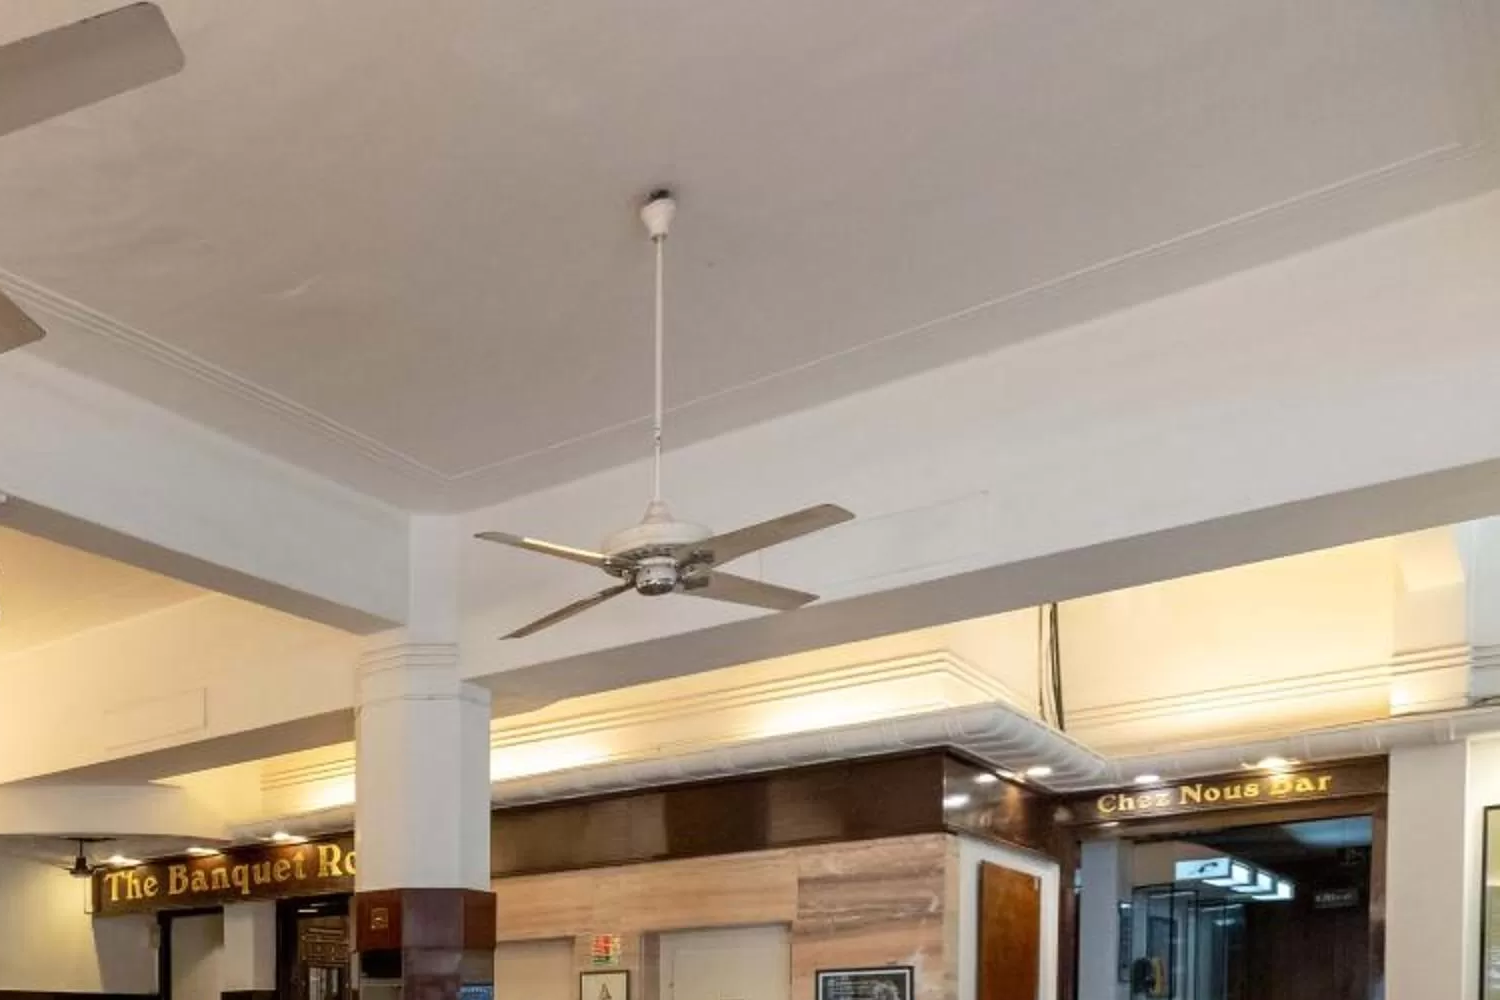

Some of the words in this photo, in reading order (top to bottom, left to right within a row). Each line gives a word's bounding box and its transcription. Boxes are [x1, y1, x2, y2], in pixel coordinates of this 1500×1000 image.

[1097, 793, 1170, 813] Chez
[1179, 783, 1258, 805] Nous
[1268, 774, 1332, 796] Bar
[104, 870, 160, 901] The
[168, 852, 308, 895] Banquet
